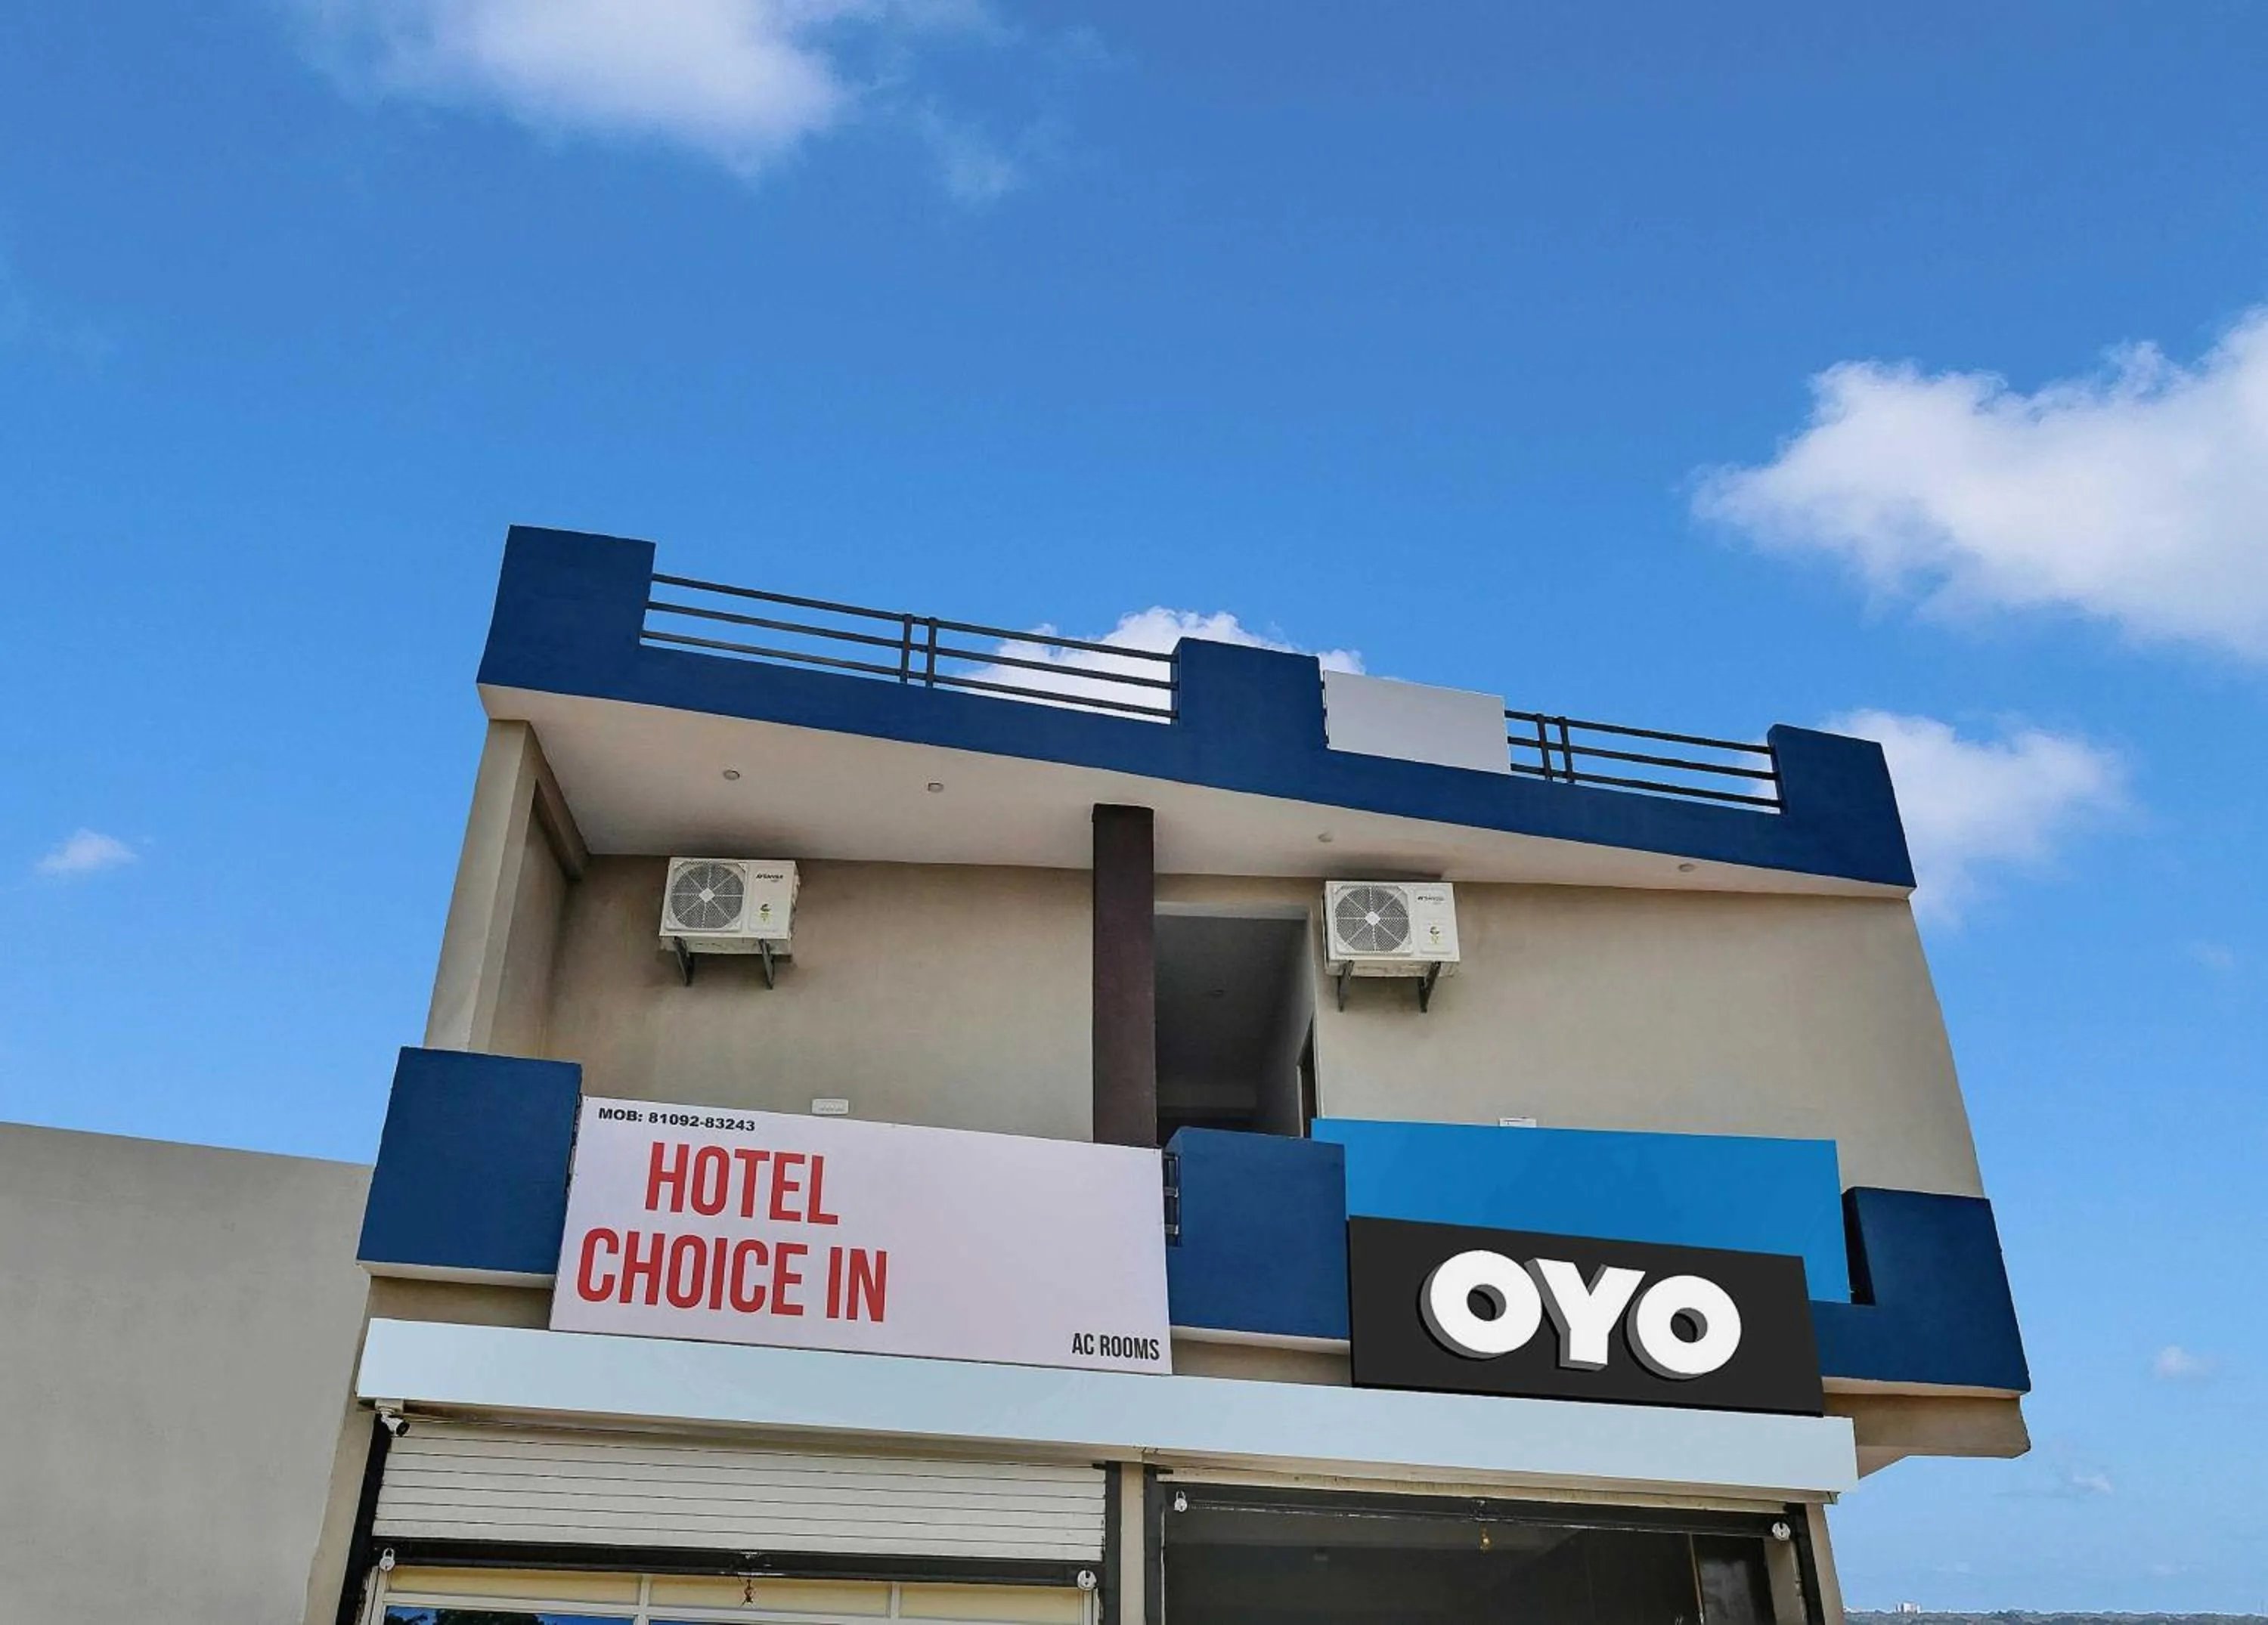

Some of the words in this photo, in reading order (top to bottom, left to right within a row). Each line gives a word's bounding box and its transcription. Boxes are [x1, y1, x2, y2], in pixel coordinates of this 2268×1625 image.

[598, 1107, 643, 1122] MOB:
[648, 1112, 755, 1131] 81092-83243
[646, 1141, 838, 1225] HOTEL
[577, 1227, 807, 1316] CHOICE
[826, 1246, 888, 1322] IN
[1421, 1249, 1741, 1380] OYO
[1071, 1332, 1095, 1356] AC
[1099, 1334, 1161, 1361] ROOMS
